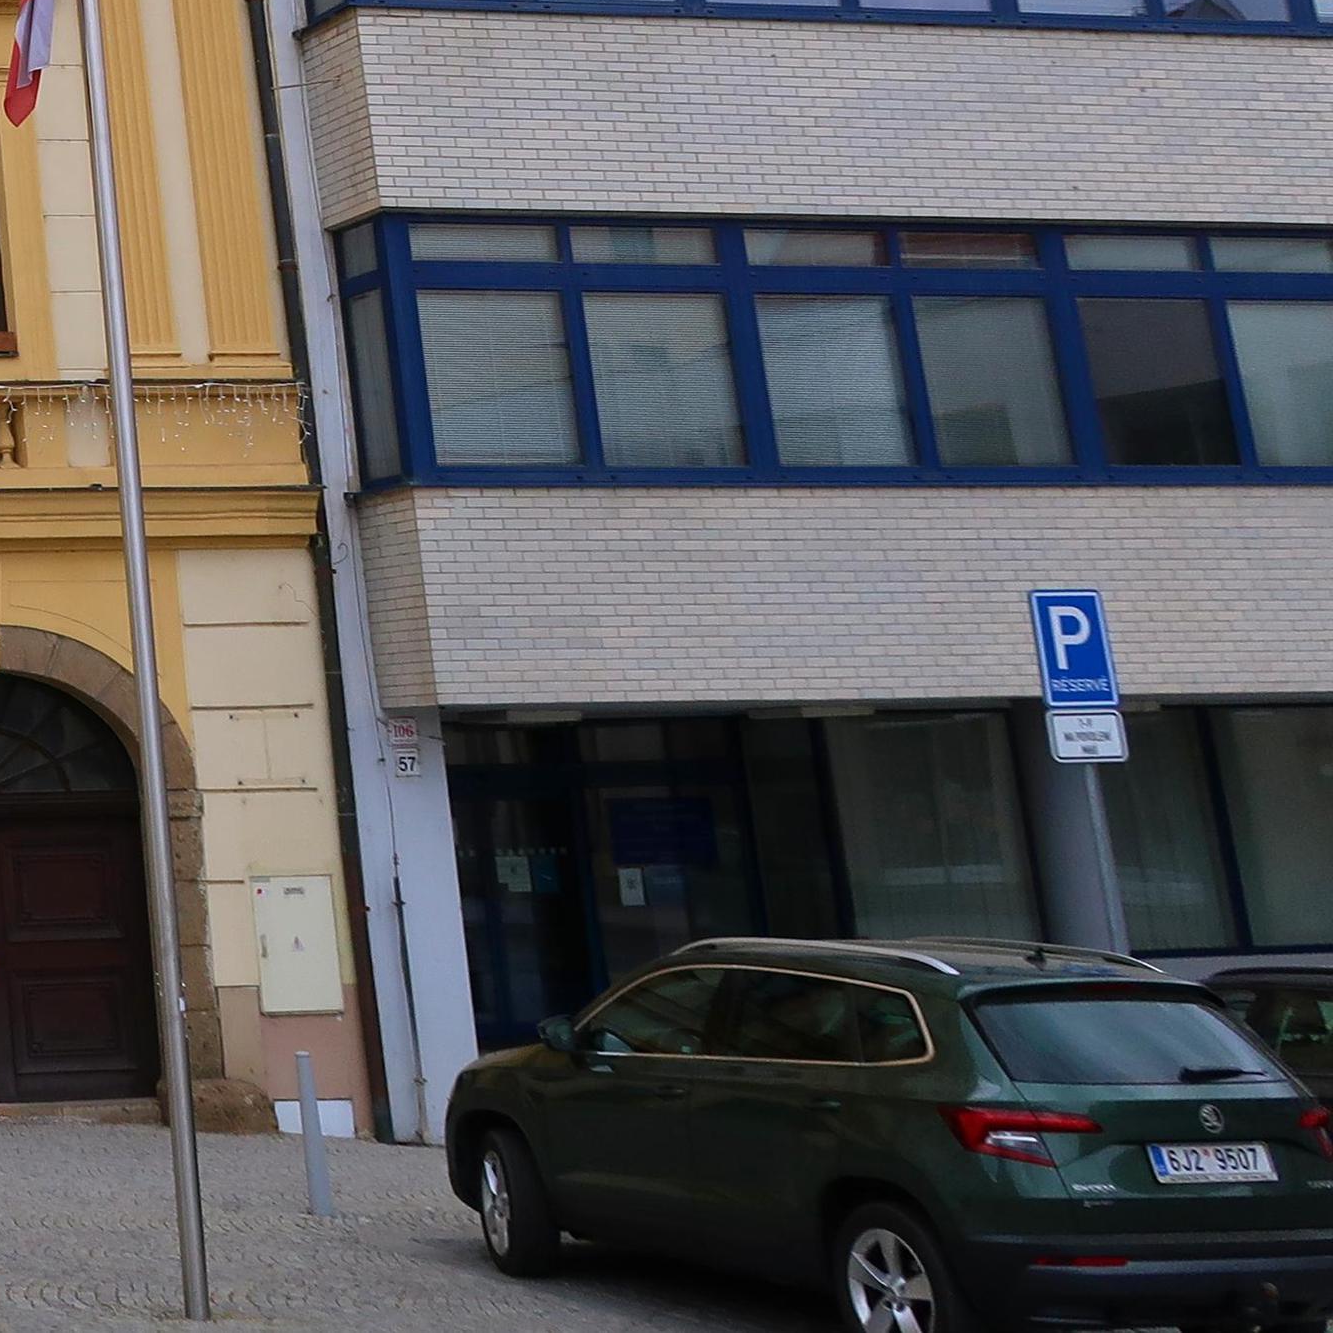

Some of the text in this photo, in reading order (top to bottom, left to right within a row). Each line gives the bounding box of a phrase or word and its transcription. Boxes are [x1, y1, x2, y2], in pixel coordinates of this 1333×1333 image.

[1048, 605, 1091, 670] P
[398, 756, 416, 772] 57
[1168, 1147, 1259, 1172] 6J2 9507
